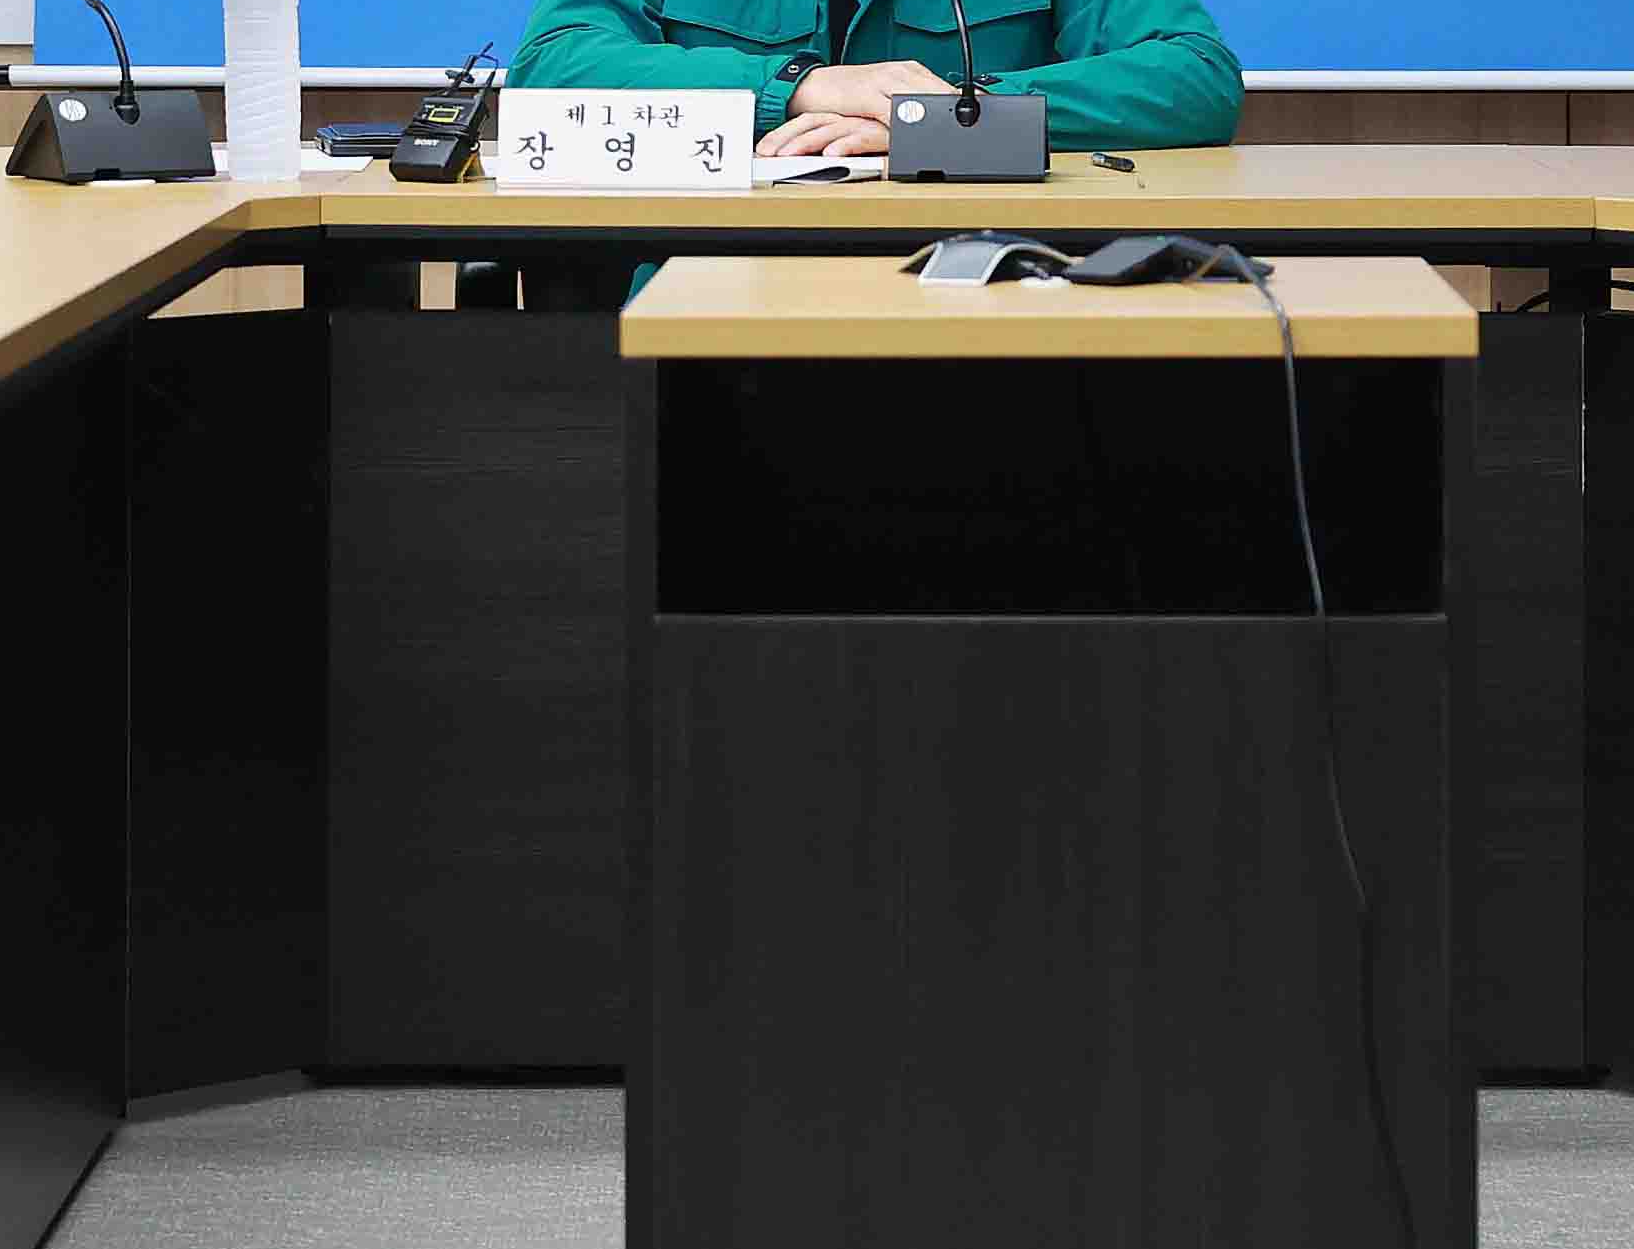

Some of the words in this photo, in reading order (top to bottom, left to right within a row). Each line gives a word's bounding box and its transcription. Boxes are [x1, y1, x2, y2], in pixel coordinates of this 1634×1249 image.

[566, 103, 585, 128] 제
[600, 105, 615, 126] 1
[632, 104, 685, 129] 차관
